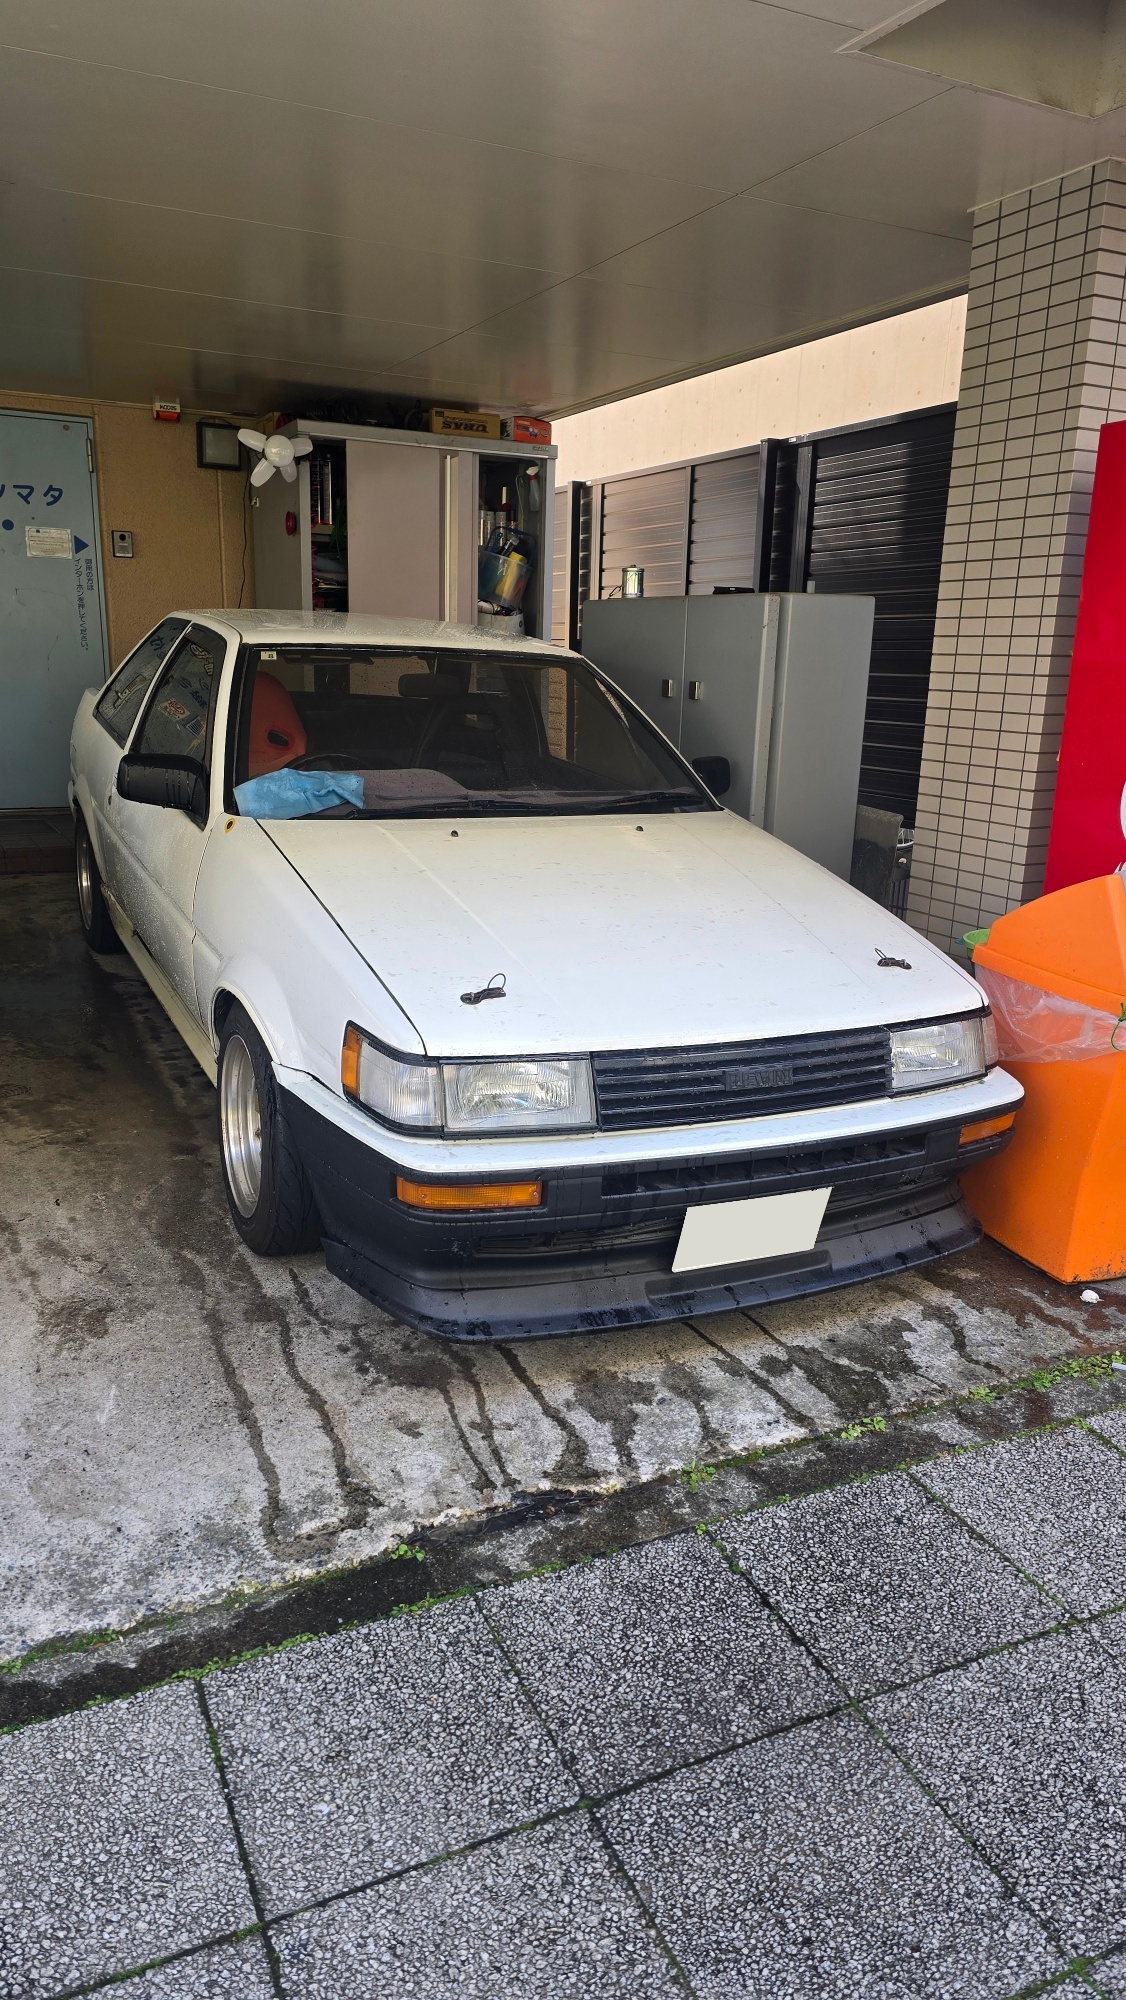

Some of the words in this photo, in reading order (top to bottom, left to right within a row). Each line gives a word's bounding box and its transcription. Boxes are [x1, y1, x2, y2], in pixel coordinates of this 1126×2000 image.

[441, 420, 489, 434] URAS
[84, 558, 95, 591] 御用の方は
